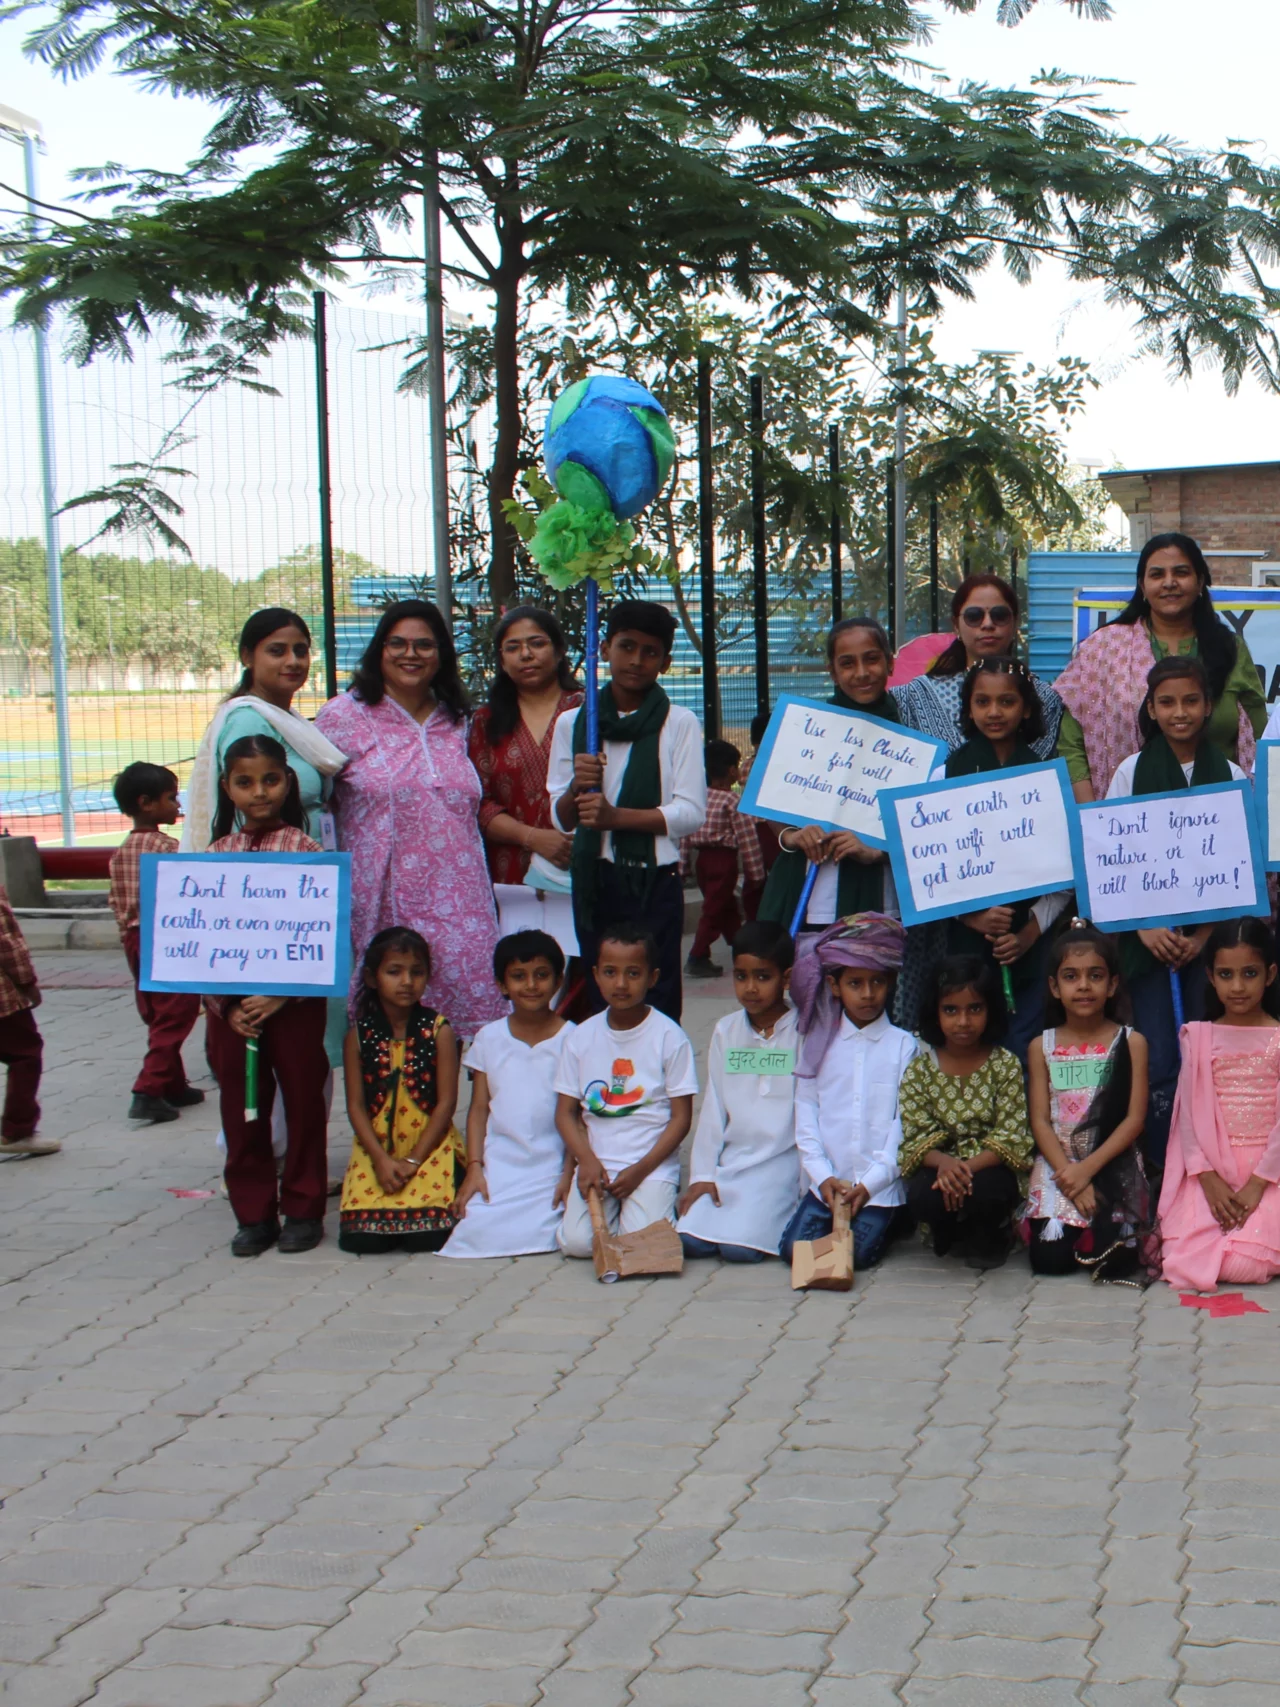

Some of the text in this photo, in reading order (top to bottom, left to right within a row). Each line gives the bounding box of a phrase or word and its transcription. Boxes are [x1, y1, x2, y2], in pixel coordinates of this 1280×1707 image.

[841, 727, 864, 748] less
[801, 748, 893, 783] or fish will
[784, 771, 877, 807] complain against
[911, 788, 1042, 828] Save earth or
[912, 817, 1036, 860] even wifi will
[1168, 810, 1220, 839] ignore
[1166, 845, 1185, 860] or
[1201, 834, 1216, 856] it
[178, 874, 330, 898] Don't harm the
[922, 859, 996, 898] get slow
[1097, 874, 1127, 895] will
[1141, 868, 1180, 891] block
[213, 918, 231, 930] or
[236, 918, 269, 930] even
[274, 919, 331, 942] oxygen
[164, 941, 324, 971] will pay on EMI
[760, 1053, 788, 1068] लाल
